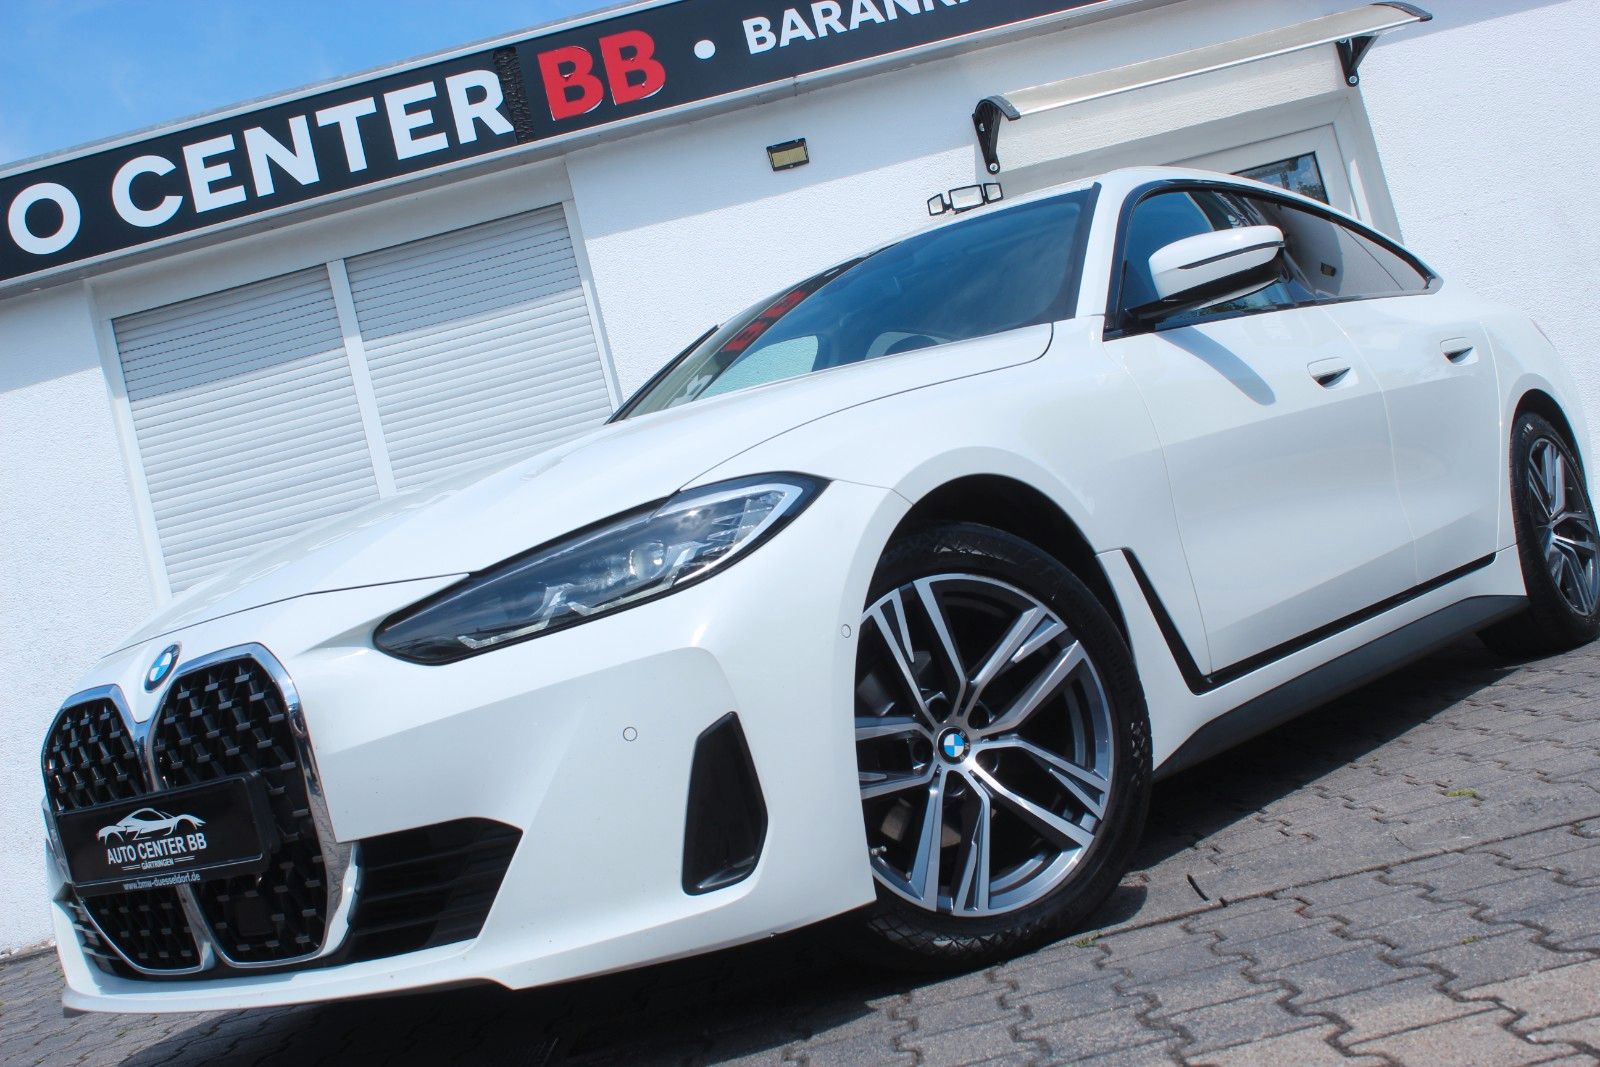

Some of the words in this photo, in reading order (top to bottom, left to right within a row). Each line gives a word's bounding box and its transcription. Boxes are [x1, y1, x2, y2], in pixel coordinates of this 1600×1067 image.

[111, 69, 515, 228] CENTER
[538, 30, 667, 121] BB
[742, 0, 969, 54] BARAN
[107, 844, 137, 865] AUTO
[137, 836, 187, 860] CENTER
[186, 832, 208, 851] BB
[123, 871, 201, 891] www.bmw-duesseldorf.de
